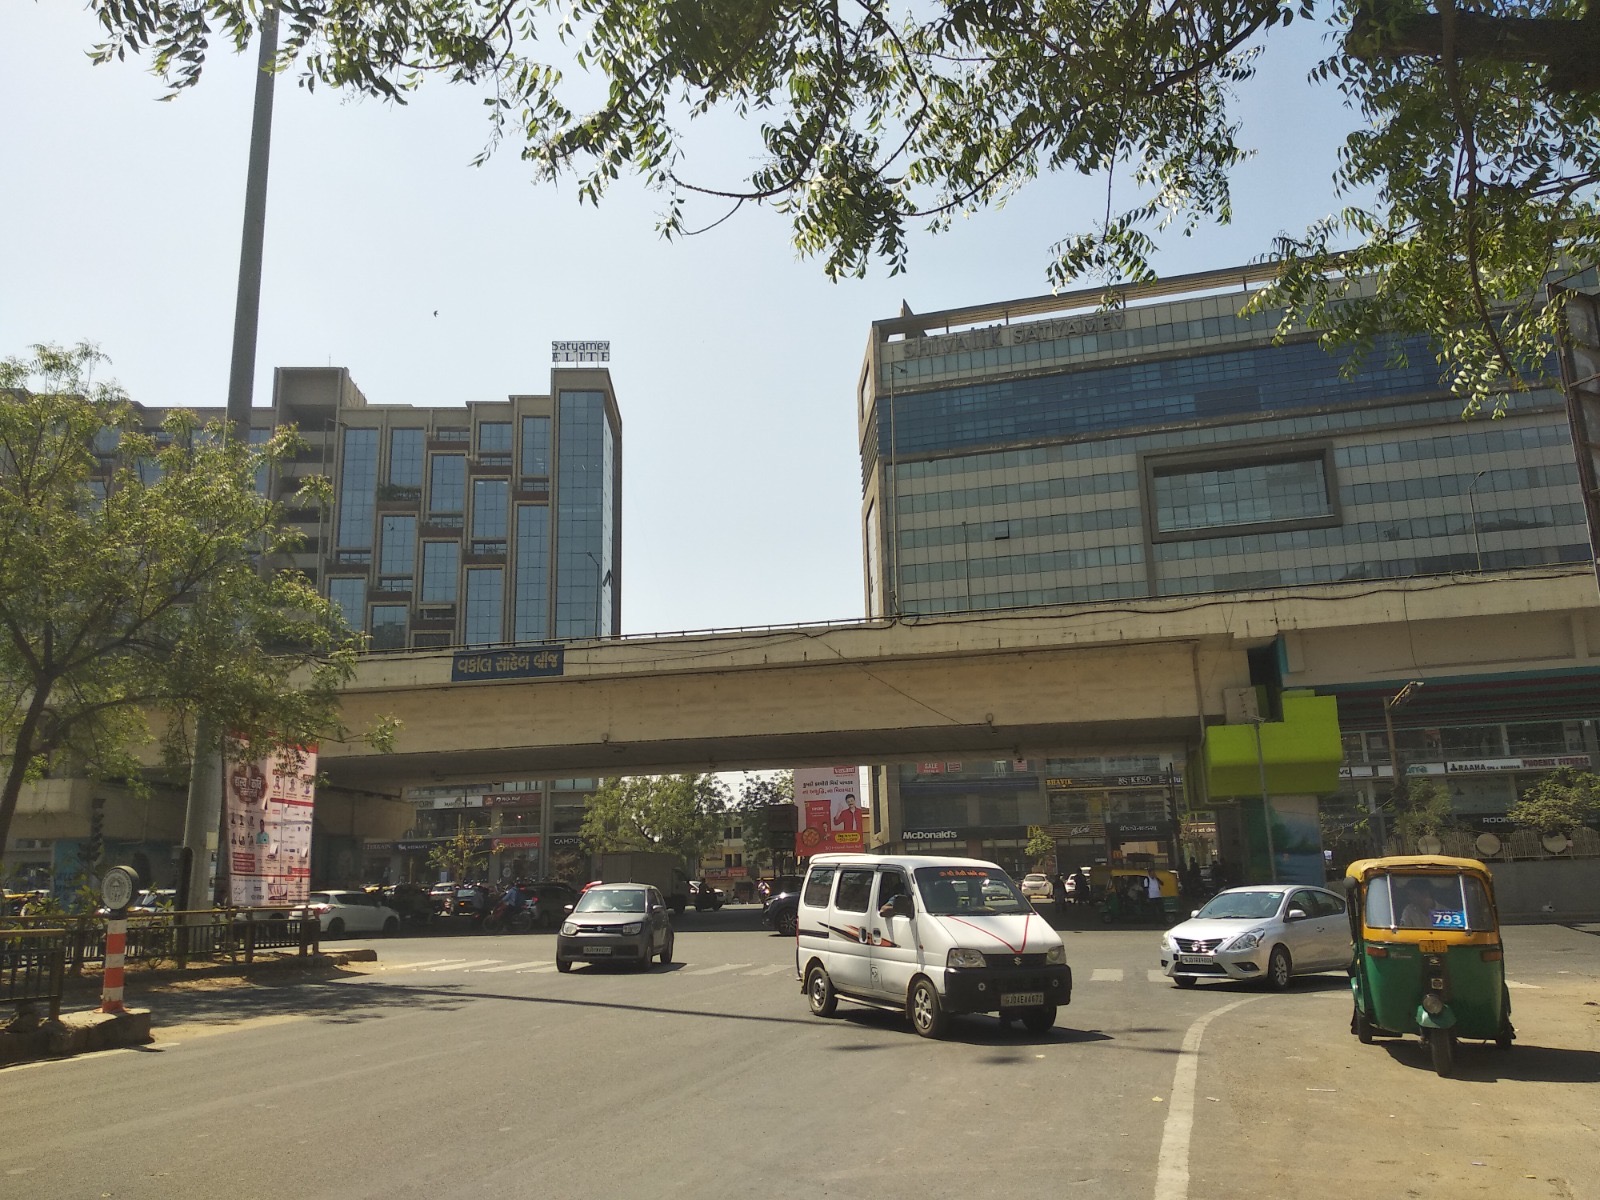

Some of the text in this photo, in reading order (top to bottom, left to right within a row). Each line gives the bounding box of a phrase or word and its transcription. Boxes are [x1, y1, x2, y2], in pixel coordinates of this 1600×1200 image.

[904, 315, 1125, 358] SHIVALIK SATYAMEV
[552, 341, 610, 353] Satyamev
[552, 352, 610, 362] ELITE
[903, 831, 957, 839] McDonald's
[1433, 914, 1462, 925] 793
